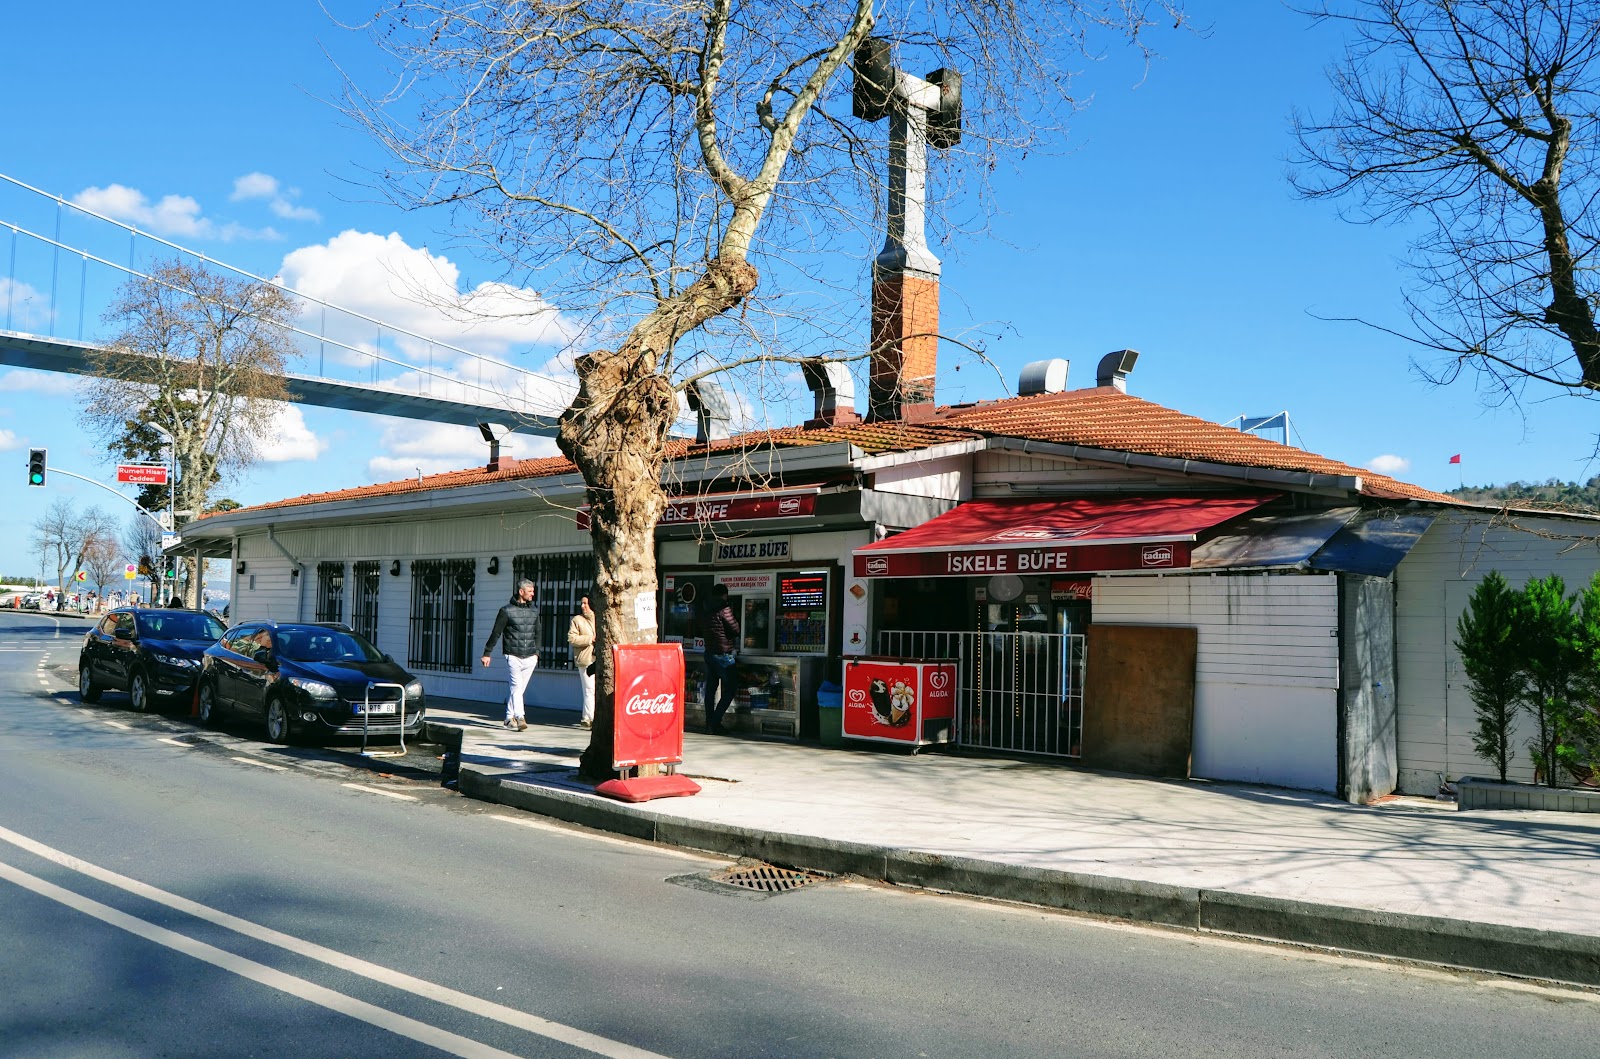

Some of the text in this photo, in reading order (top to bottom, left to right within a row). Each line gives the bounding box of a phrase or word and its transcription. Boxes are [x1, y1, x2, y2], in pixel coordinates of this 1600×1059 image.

[693, 502, 729, 518] BÜFE
[759, 539, 789, 557] BÜFE
[867, 549, 1171, 572] tadım İSKELE BÜFE tadım
[625, 693, 676, 716] Coca-Cola
